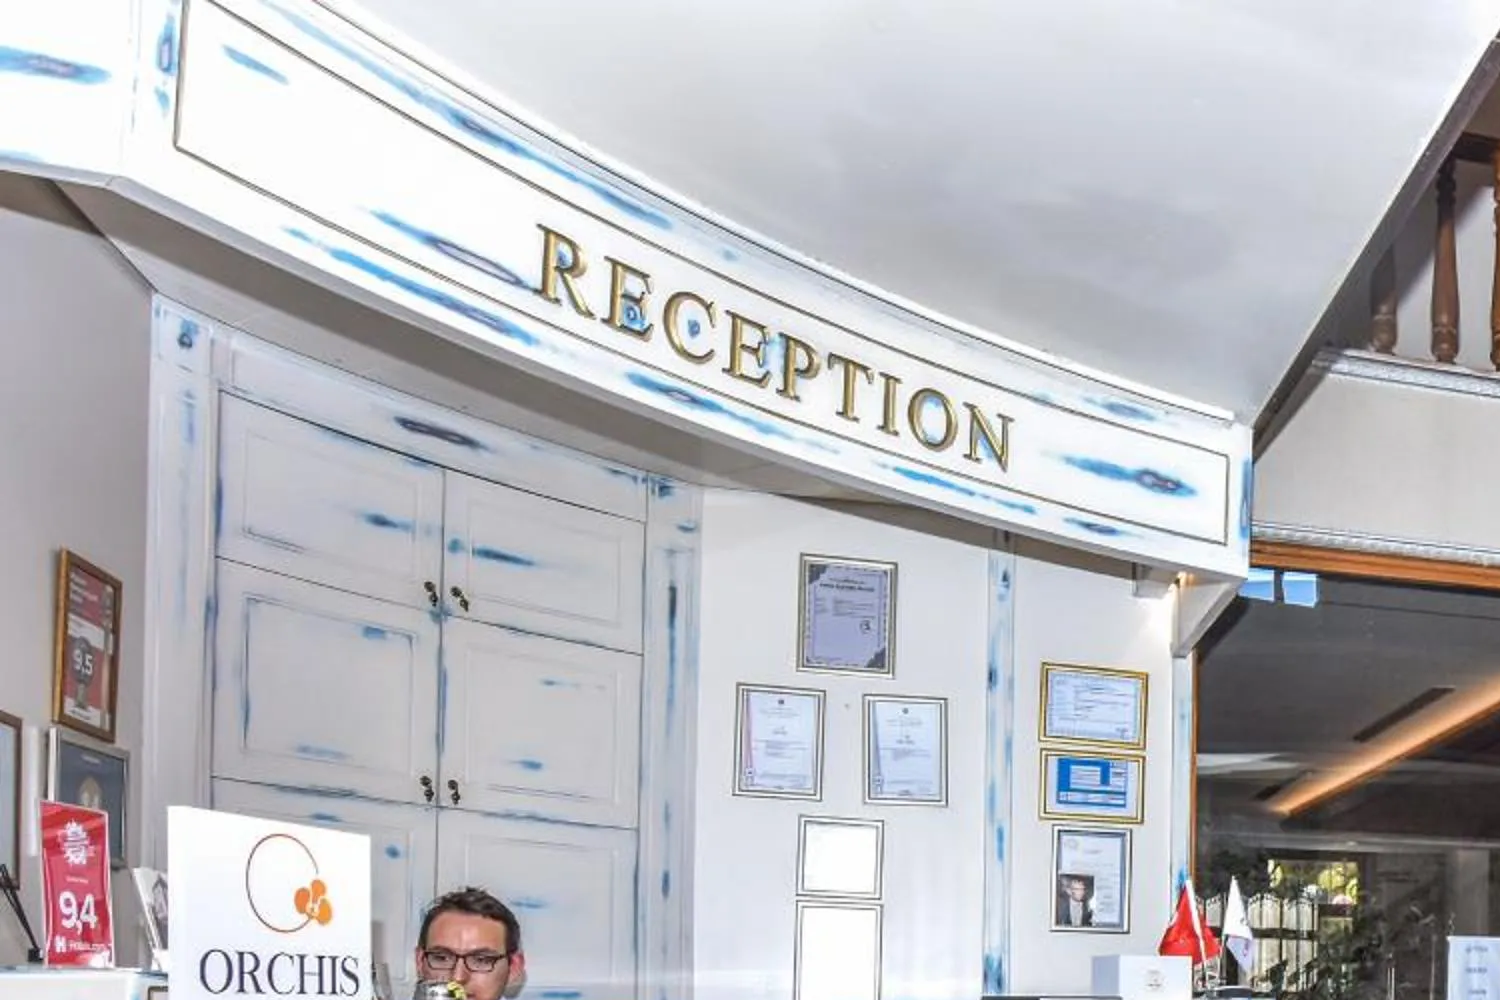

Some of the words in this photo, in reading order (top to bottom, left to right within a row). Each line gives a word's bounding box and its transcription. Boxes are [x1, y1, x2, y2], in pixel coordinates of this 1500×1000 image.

[536, 223, 1014, 472] RECEPTION
[58, 890, 98, 935] 9,4
[200, 949, 360, 996] ORCHIS
